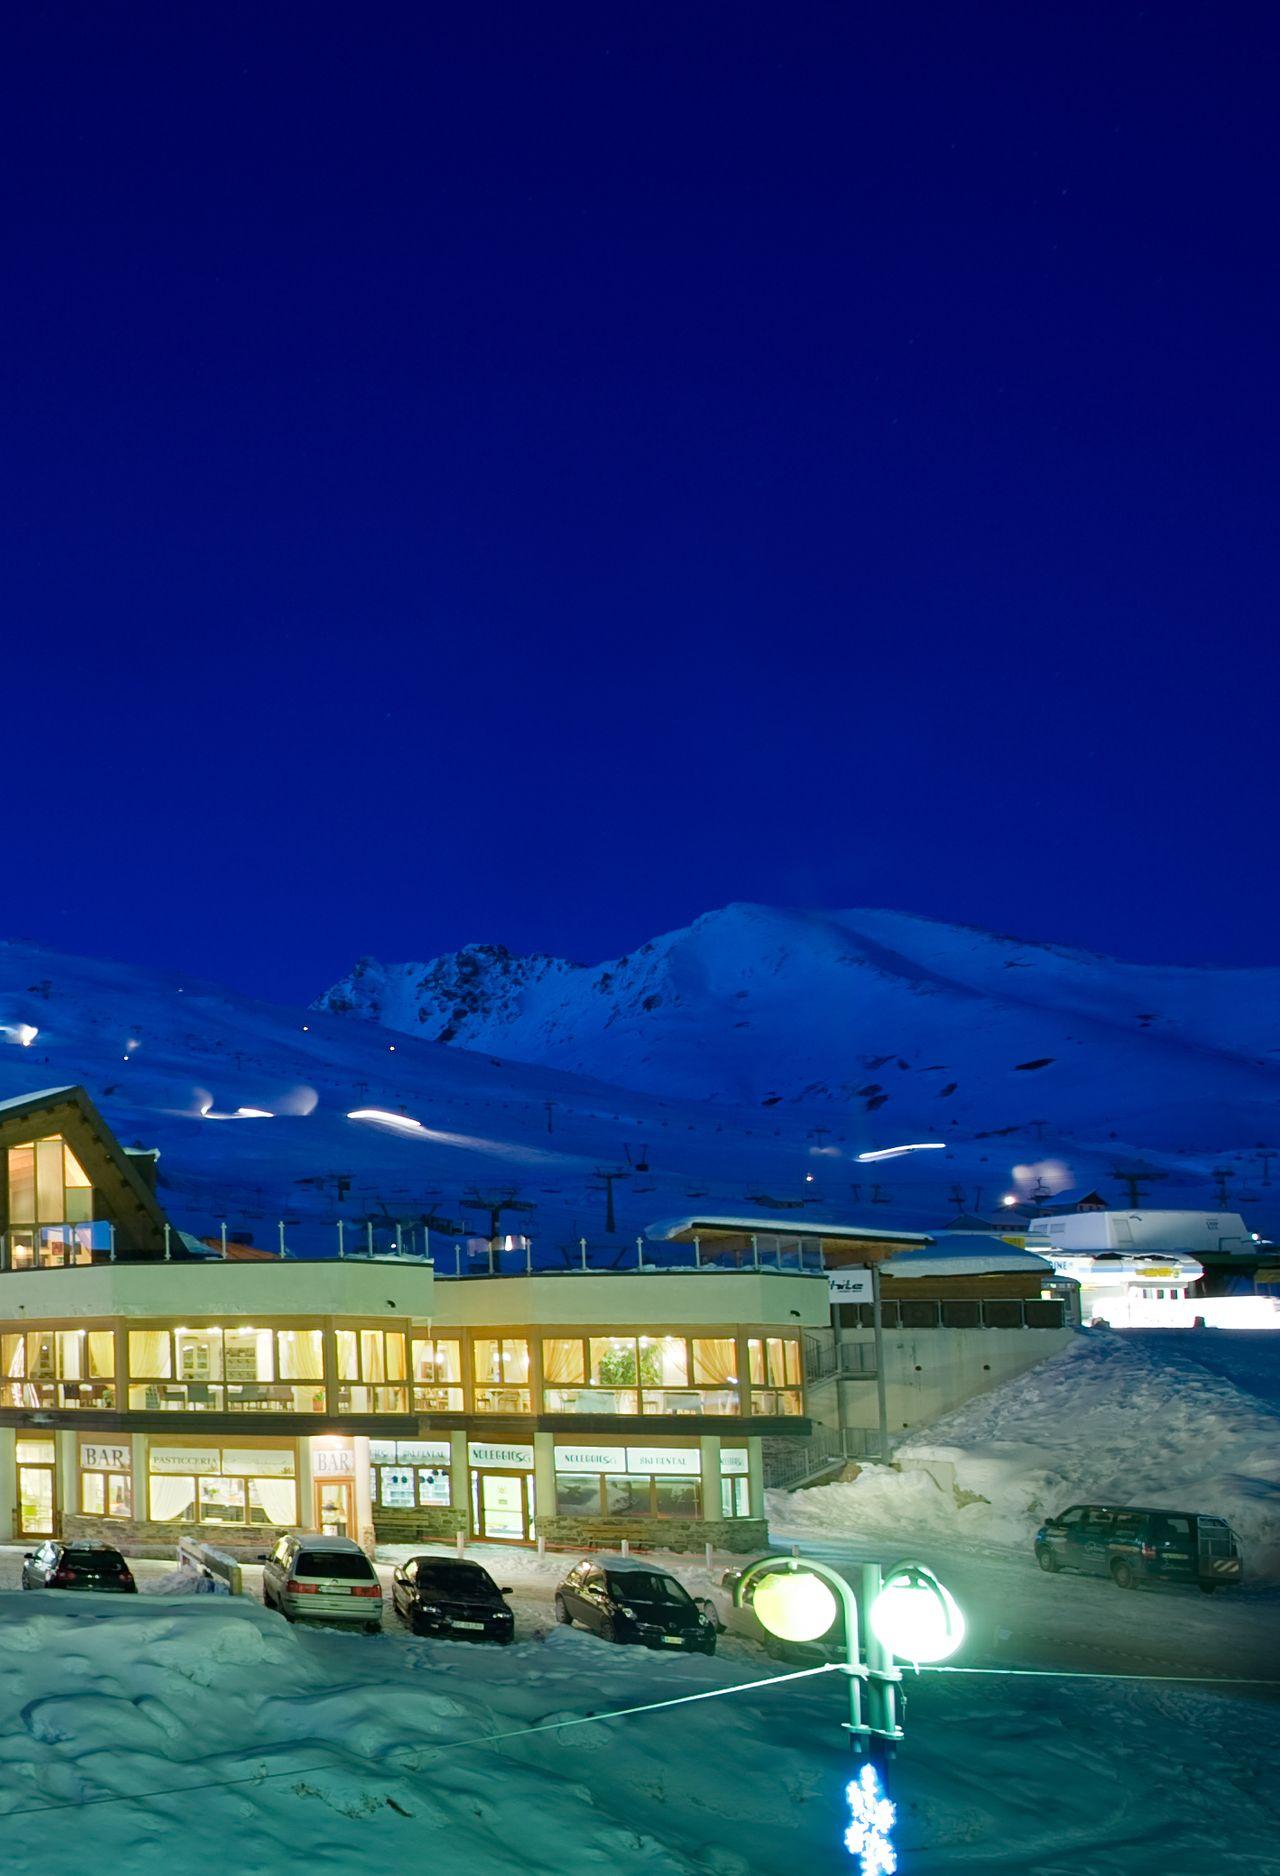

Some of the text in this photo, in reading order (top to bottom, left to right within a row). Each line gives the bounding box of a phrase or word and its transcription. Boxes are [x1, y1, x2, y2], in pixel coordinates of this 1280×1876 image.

[85, 1447, 124, 1467] BAR
[153, 1456, 217, 1466] PASTICCERIA
[318, 1453, 350, 1471] BAR
